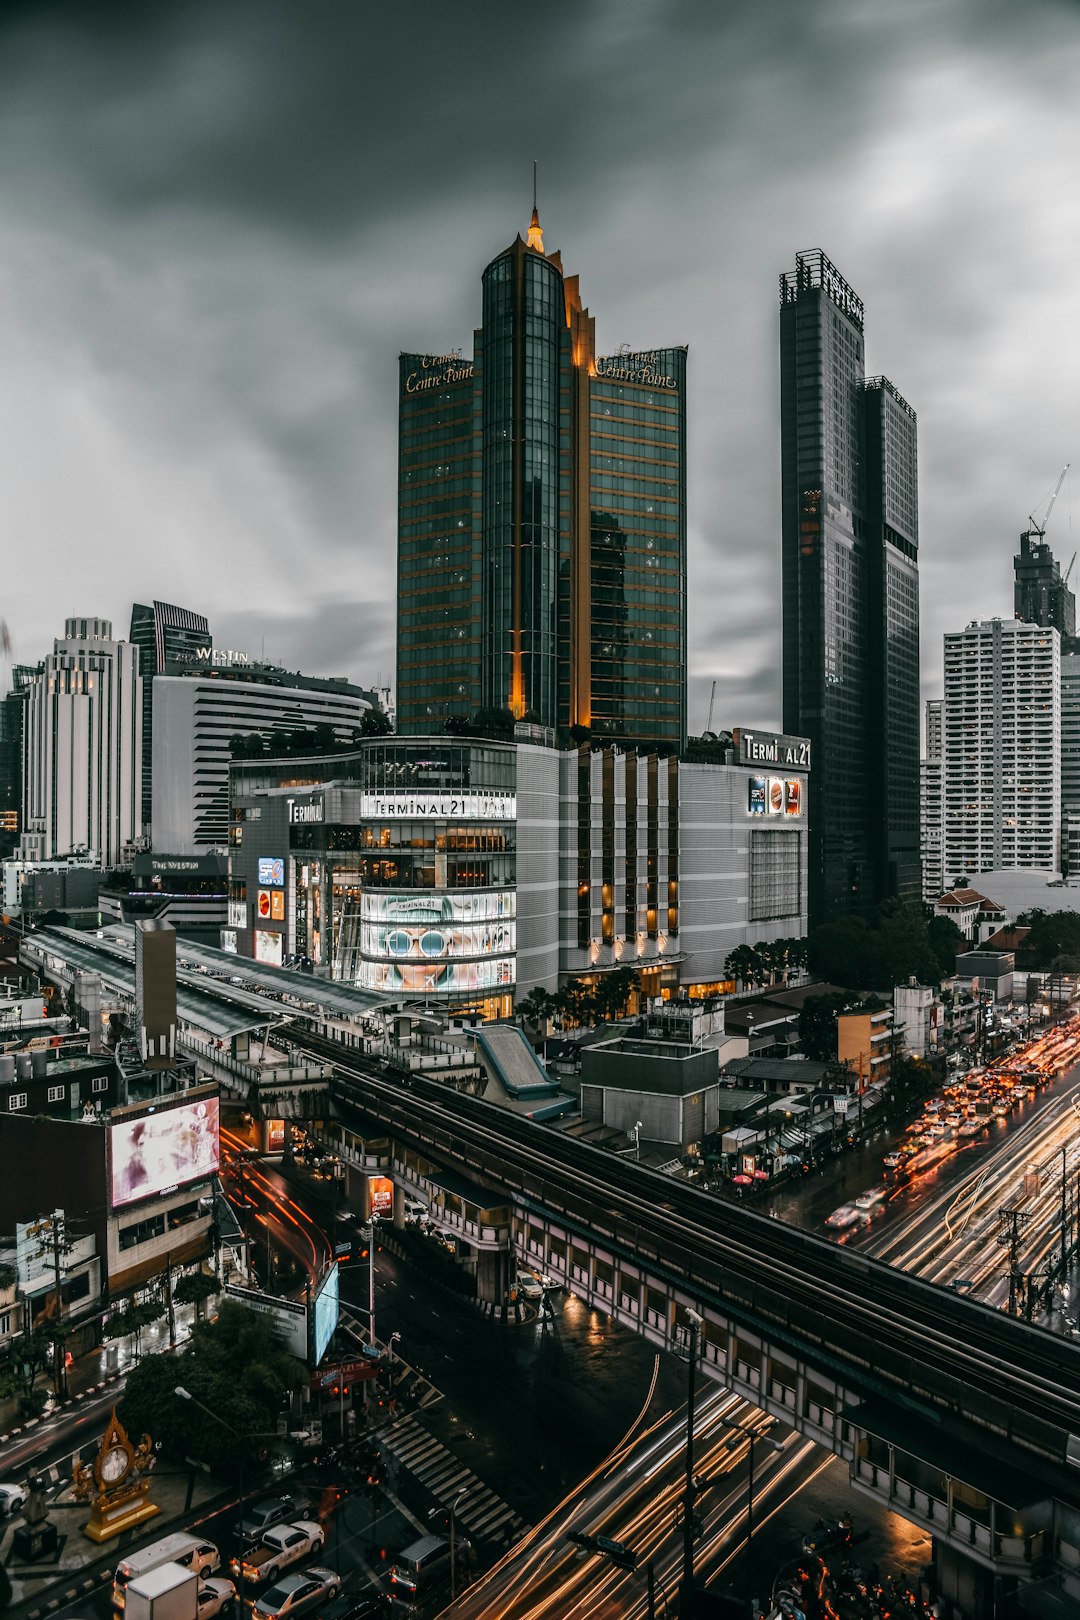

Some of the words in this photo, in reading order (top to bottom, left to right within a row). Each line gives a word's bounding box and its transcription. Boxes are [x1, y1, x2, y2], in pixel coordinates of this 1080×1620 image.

[406, 372, 442, 393] Centre
[442, 364, 474, 384] Point
[594, 356, 636, 381] Centre
[637, 364, 677, 389] Point
[196, 646, 249, 662] WESTIN
